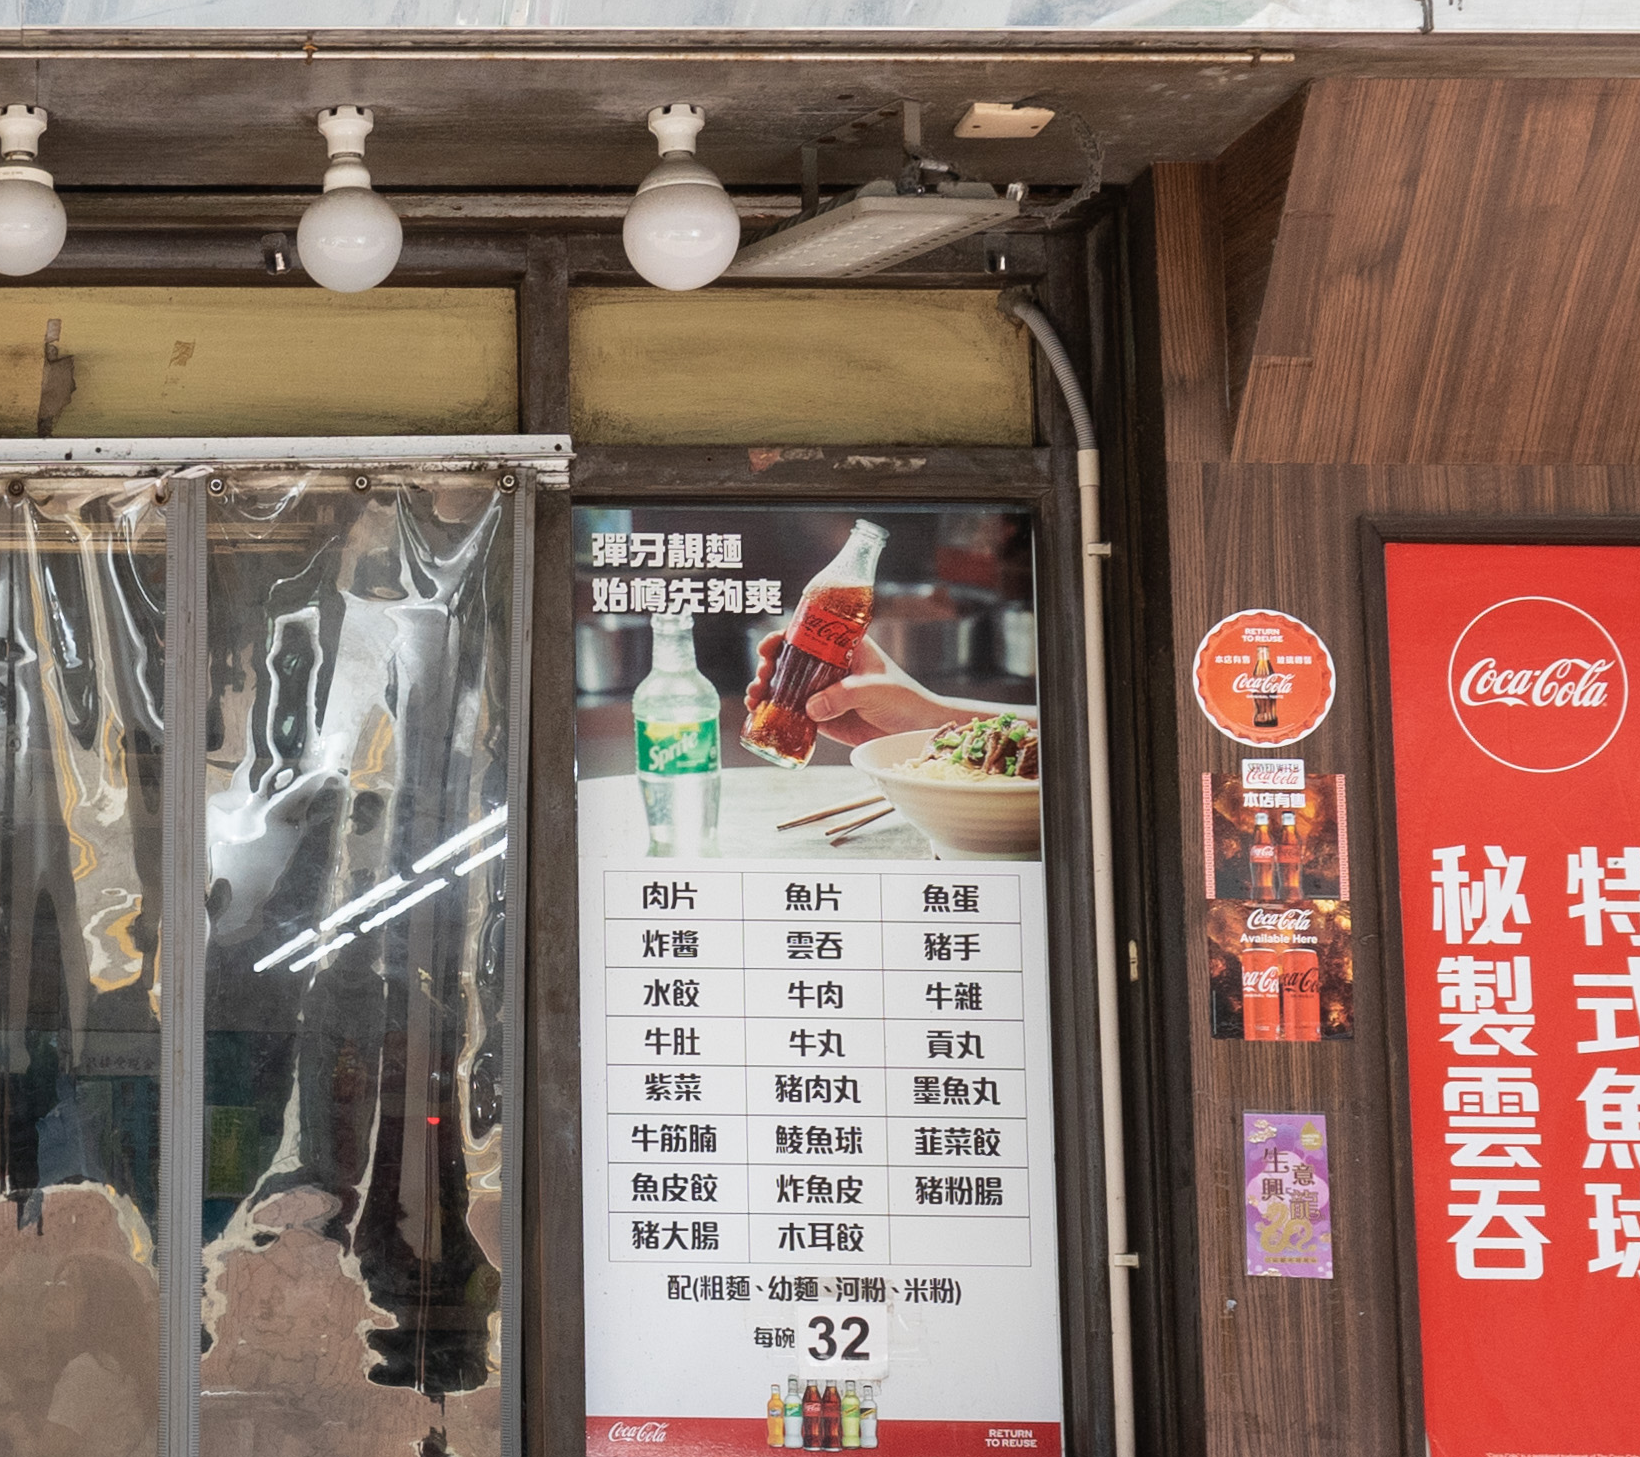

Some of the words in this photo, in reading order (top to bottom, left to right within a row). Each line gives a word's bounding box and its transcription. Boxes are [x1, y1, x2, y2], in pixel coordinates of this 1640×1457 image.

[590, 532, 743, 569] 彈牙靚麵
[591, 578, 783, 616] 始樽先夠爽
[1232, 672, 1296, 694] Coca-Cola
[1459, 657, 1616, 709] Coca-Cola
[641, 881, 699, 911] 肉片
[784, 882, 843, 912] 魚片
[922, 884, 980, 914] 魚蛋
[1246, 907, 1312, 931] Coca-Cola
[641, 929, 700, 959] 炸醬
[785, 931, 844, 961] 雲吞
[1240, 932, 1289, 945] Available
[1292, 933, 1318, 944] Here
[643, 978, 701, 1008] 水餃
[787, 980, 844, 1010] 牛肉
[1431, 844, 1552, 1281] 秘製雲吞
[774, 1073, 862, 1105] 豬肉丸
[913, 1076, 1001, 1107] 墨魚丸
[631, 1124, 718, 1155] 牛筋腩
[775, 1125, 863, 1156] 鯪魚球
[753, 1326, 795, 1350] 每碗
[807, 1315, 871, 1362] 32
[608, 1421, 667, 1443] Coca-Cola
